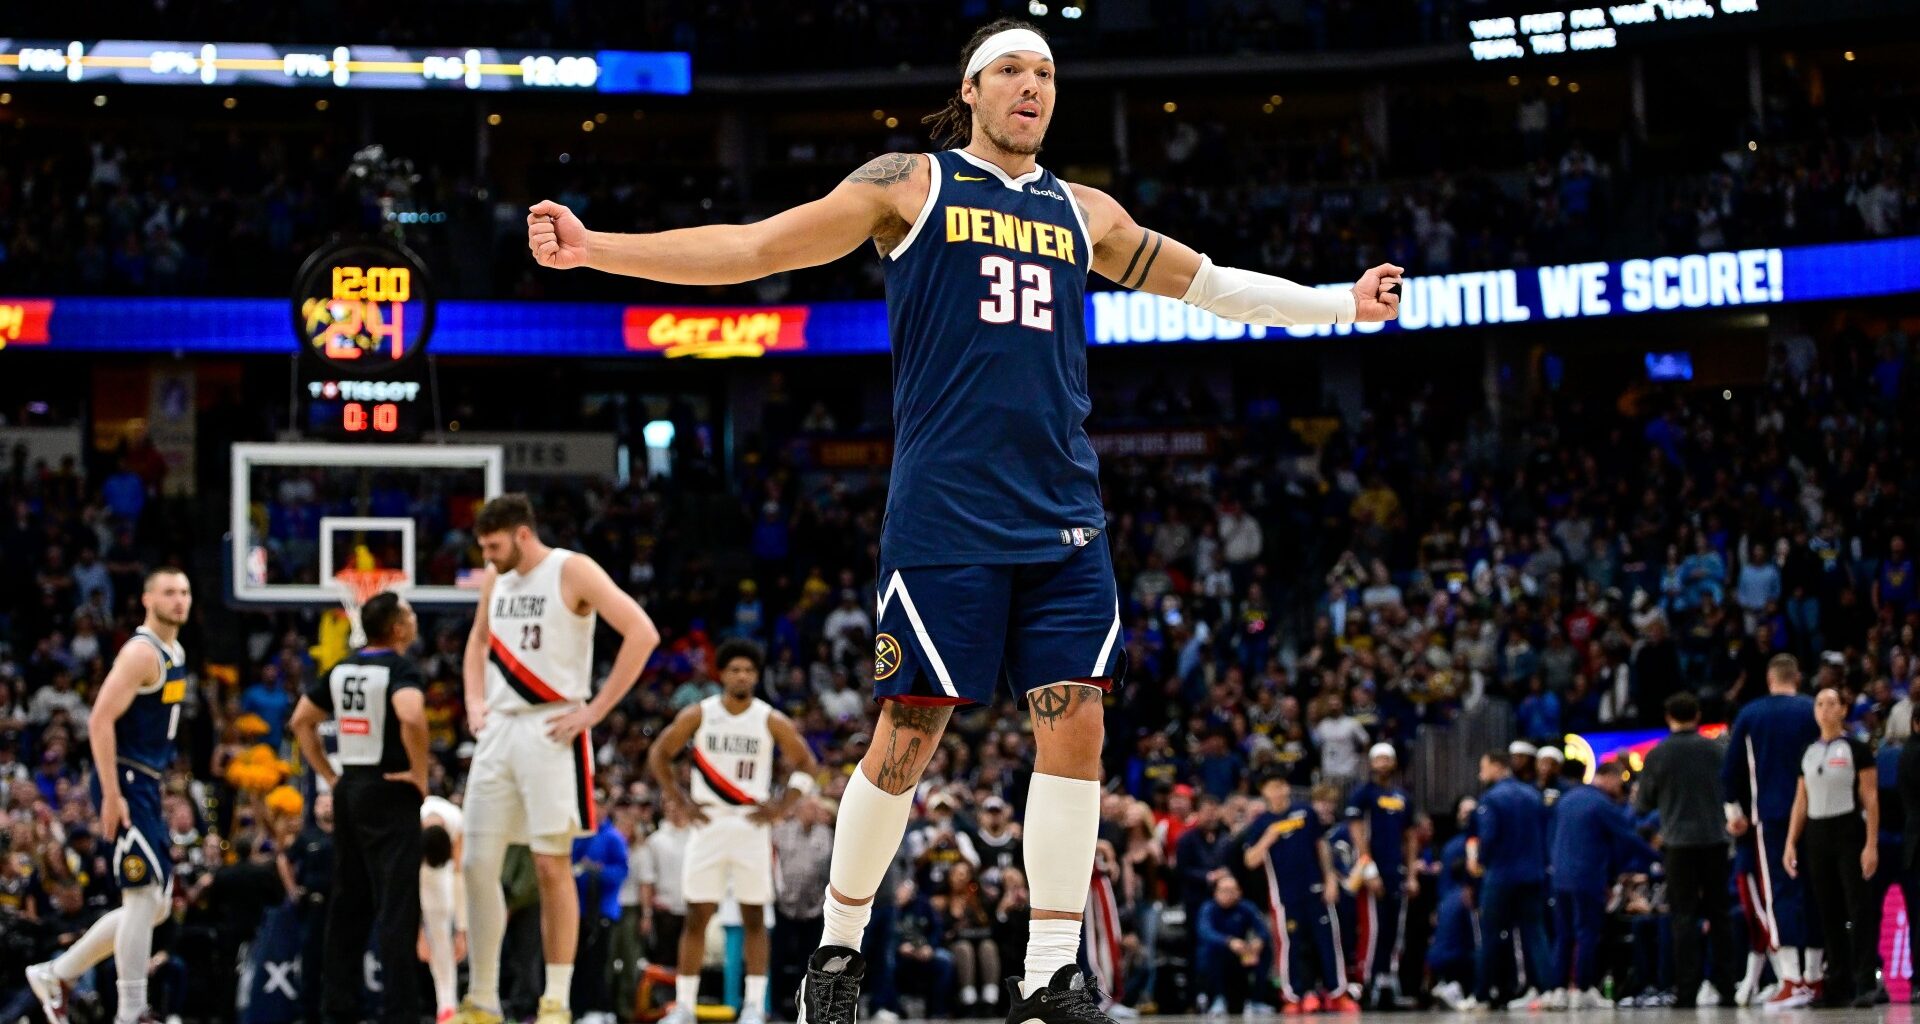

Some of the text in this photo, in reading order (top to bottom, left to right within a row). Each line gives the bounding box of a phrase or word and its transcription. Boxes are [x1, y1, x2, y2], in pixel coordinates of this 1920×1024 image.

[1030, 184, 1065, 201] ibotta
[944, 205, 1077, 266] DENVER
[332, 266, 411, 302] 12:00
[978, 254, 1054, 332] 32
[1398, 269, 1530, 330] UNTIL
[1539, 261, 1611, 319] WE
[1621, 248, 1784, 313] SCORE!
[647, 311, 781, 347] GET UP!
[343, 402, 398, 433] 0:10
[495, 596, 546, 618] BLAZERS
[520, 624, 542, 650] 23
[342, 676, 368, 711] 55
[706, 734, 759, 754] BLAZERS
